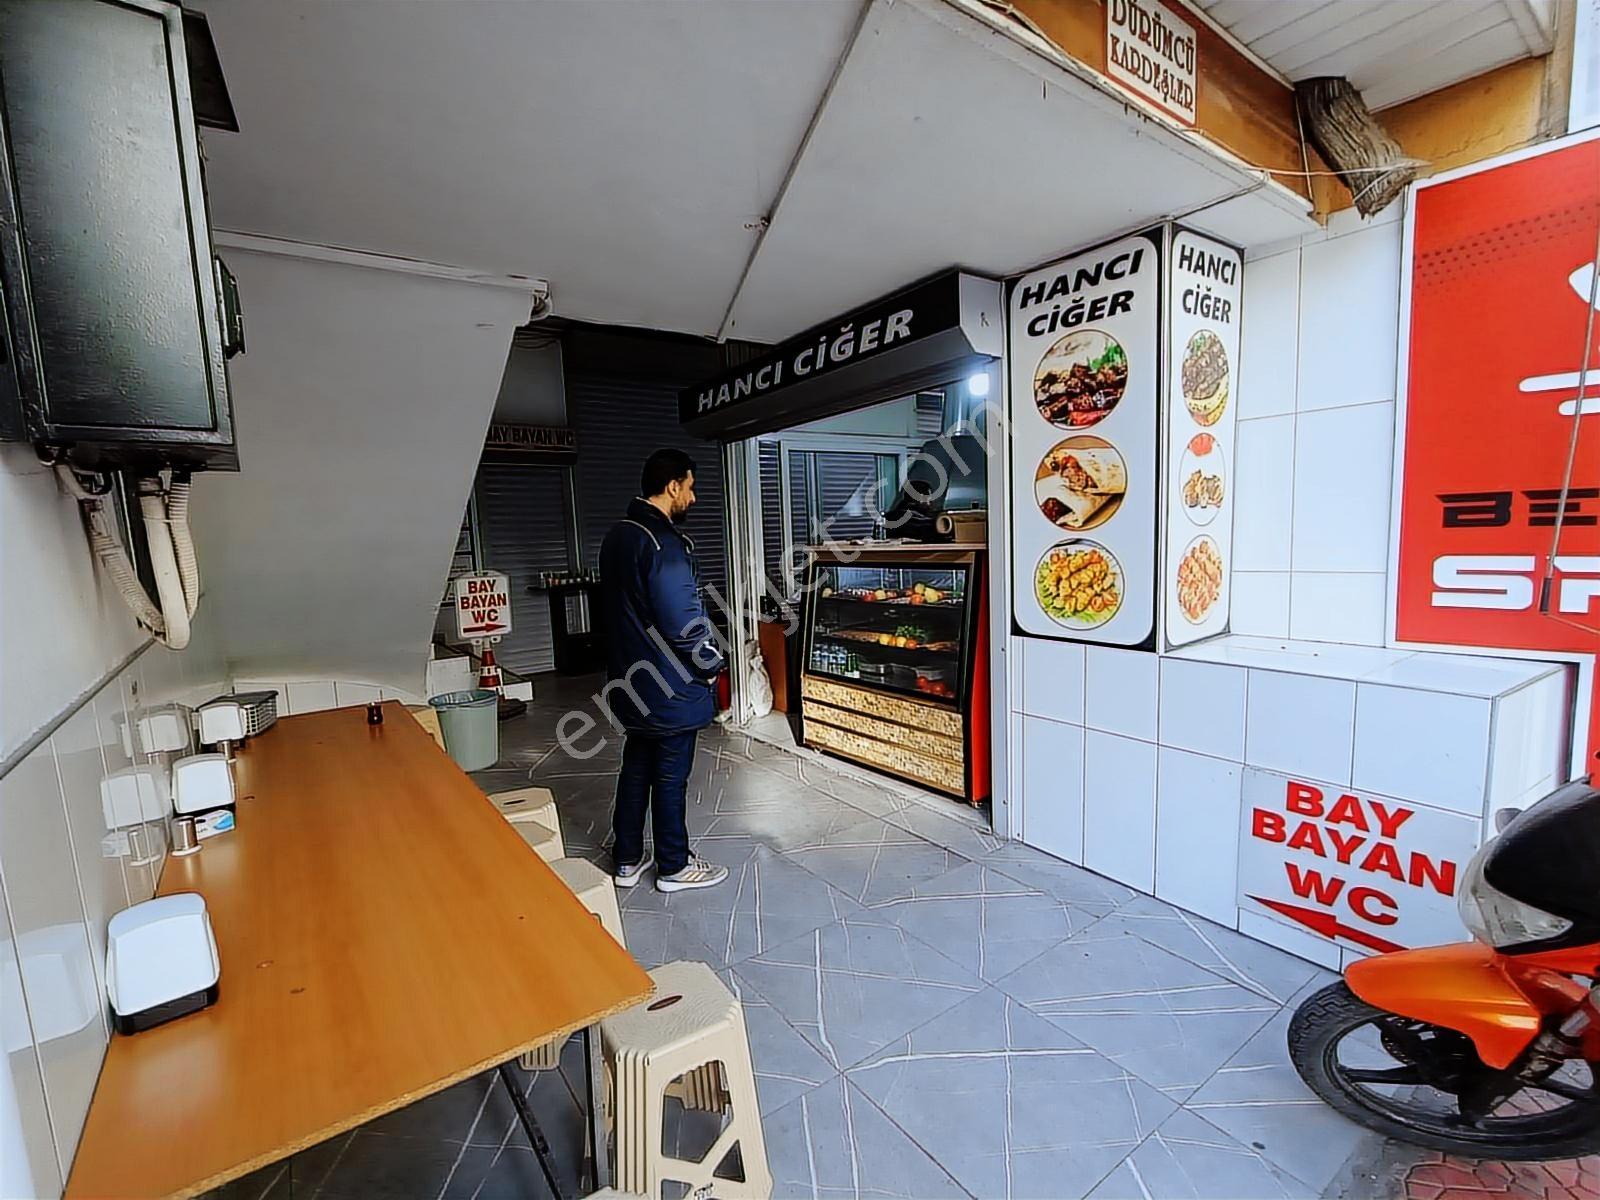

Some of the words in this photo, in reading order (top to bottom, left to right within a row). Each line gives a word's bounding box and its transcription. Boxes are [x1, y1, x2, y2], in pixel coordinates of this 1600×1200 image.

[1111, 0, 1194, 75] DÜRÜMCÜ
[1110, 33, 1194, 112] KARDEŞLER
[1019, 248, 1145, 309] HANCI
[1179, 244, 1238, 286] HANCI
[1026, 289, 1135, 337] CİĞER
[1181, 283, 1231, 324] CİĞER
[697, 360, 783, 413] HANCI
[793, 308, 914, 376] CİĞER
[460, 593, 507, 610] BAYAN
[467, 579, 497, 594] BAY
[471, 608, 499, 623] WC
[1286, 780, 1415, 839] BAY
[1251, 807, 1457, 897] BAYAN
[1284, 861, 1399, 926] WC
